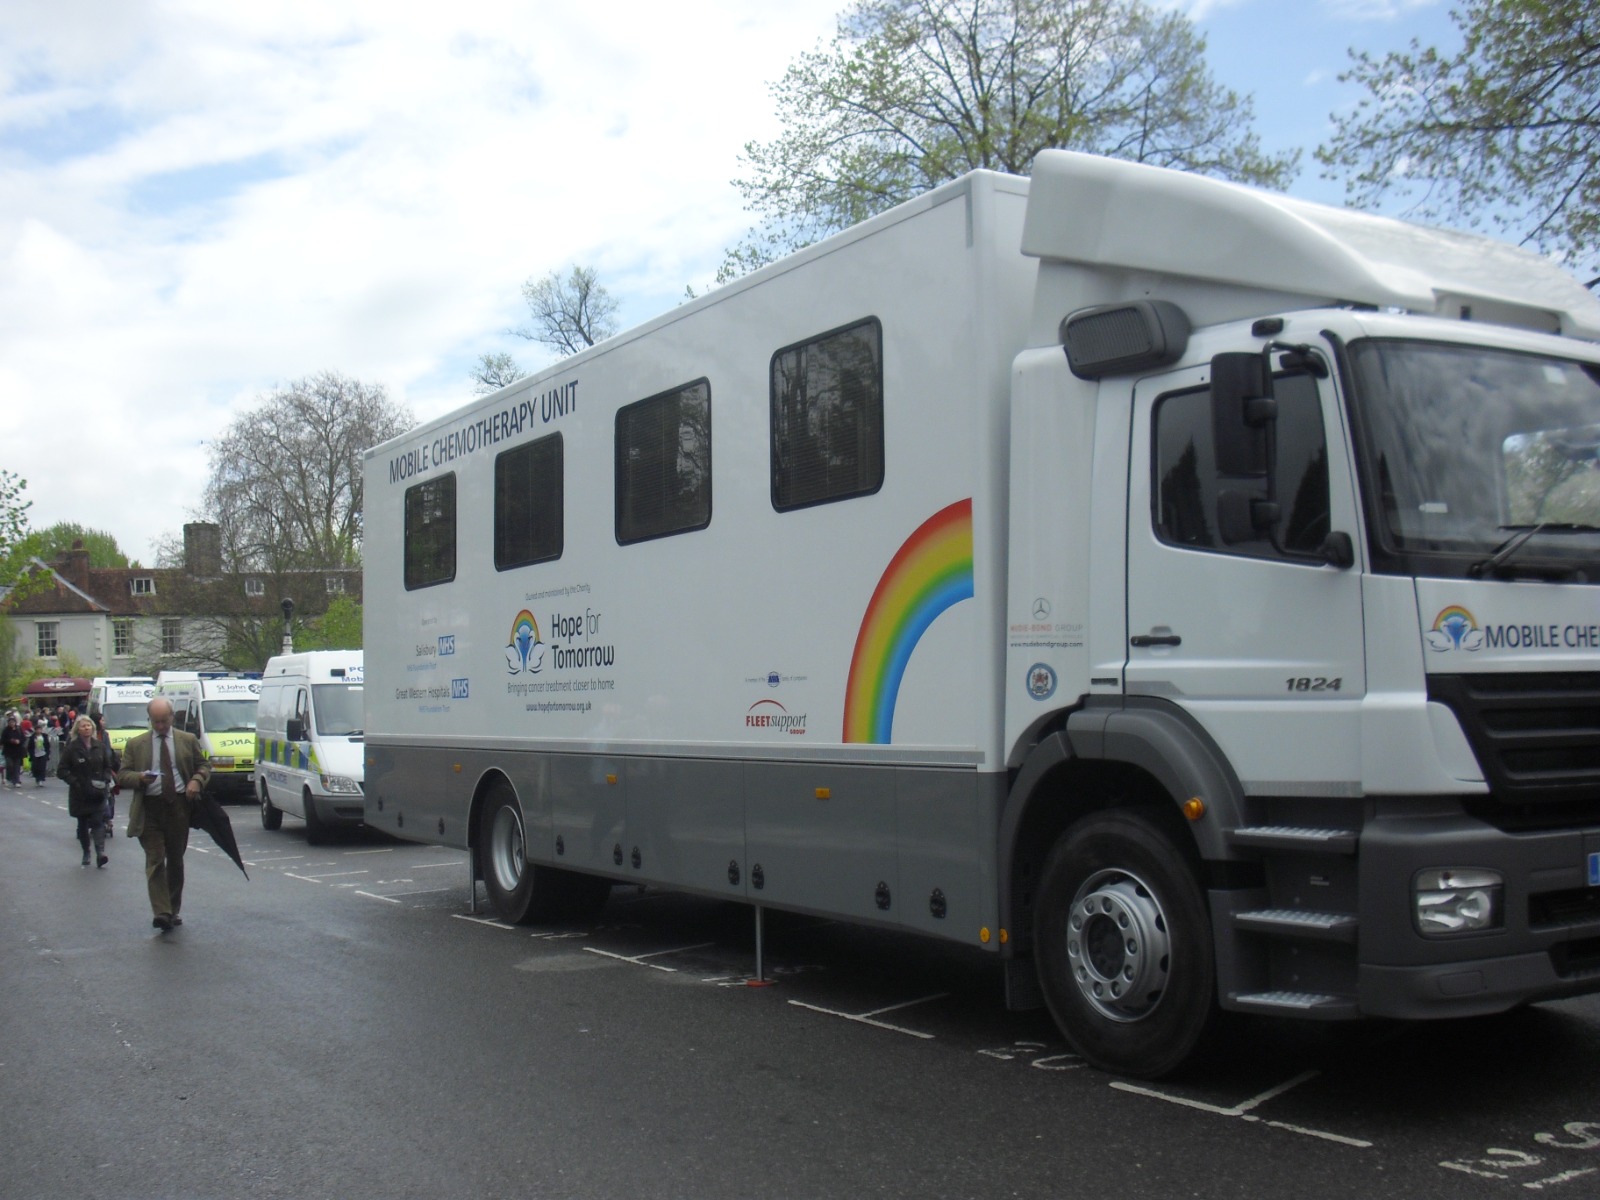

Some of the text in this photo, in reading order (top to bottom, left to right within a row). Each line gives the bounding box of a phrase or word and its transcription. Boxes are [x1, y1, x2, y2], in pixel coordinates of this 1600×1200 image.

[389, 380, 578, 484] MOBILE CHEMOTHERAPY UNIT
[552, 608, 601, 644] Hope for
[1055, 624, 1083, 632] GROUP
[1486, 625, 1559, 648] MOBILE
[416, 636, 454, 658] Salisbury NHS
[552, 645, 614, 669] Tomorrow
[396, 680, 468, 700] Great Western Hospitals NHS
[508, 678, 615, 696] Bringing cancer treatment closer to home
[1286, 677, 1342, 691] 1824
[267, 769, 288, 784] POLICE
